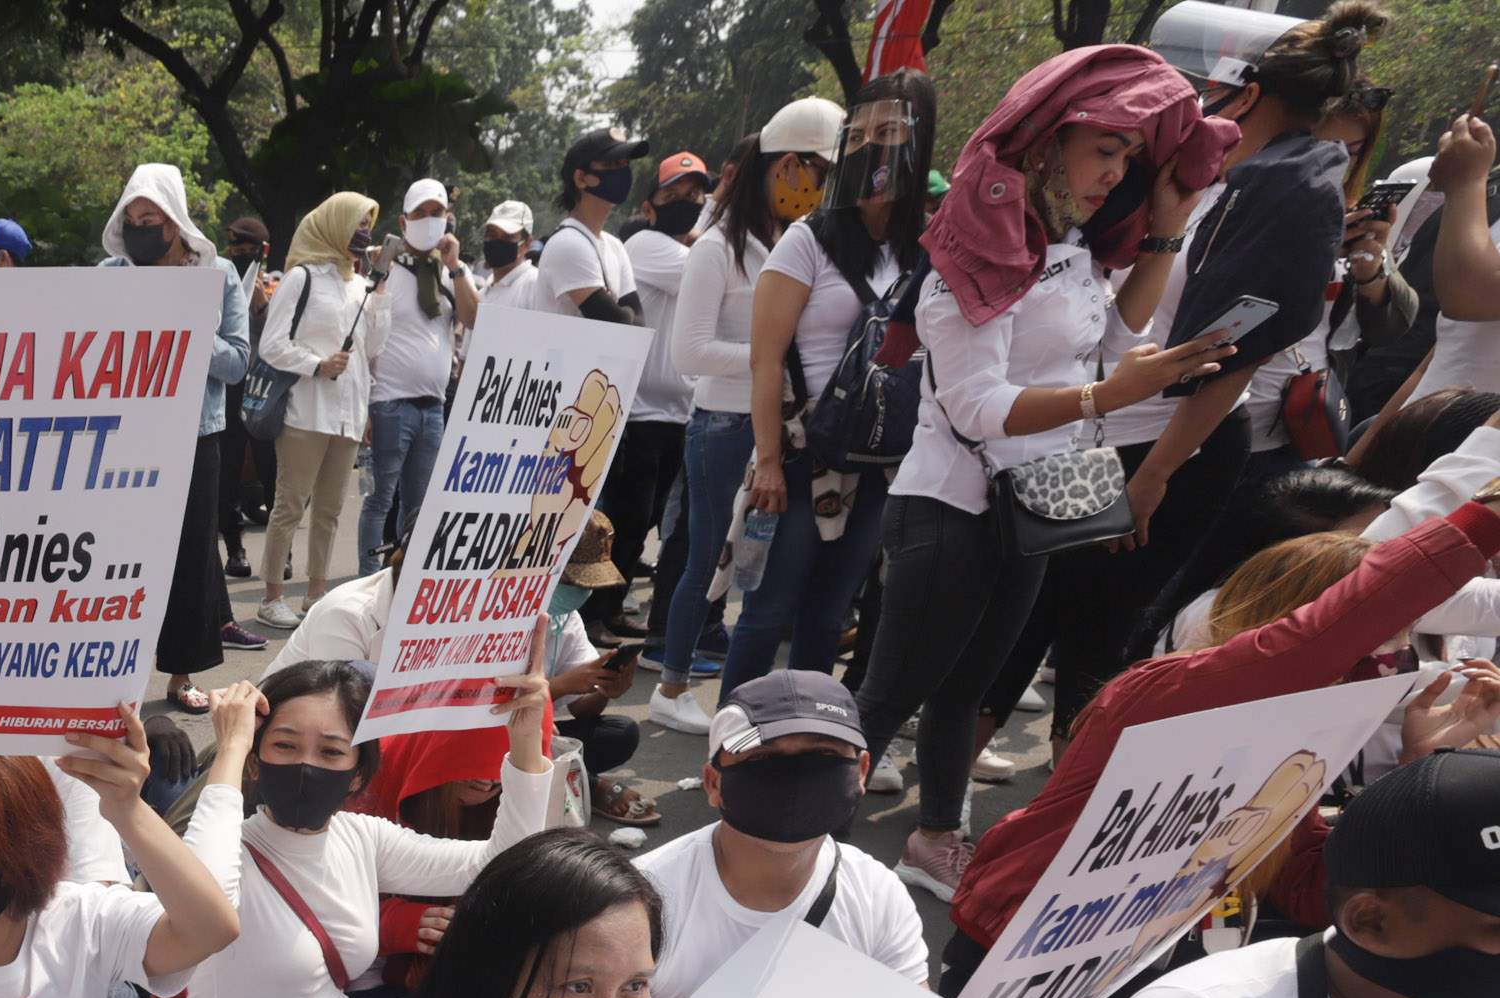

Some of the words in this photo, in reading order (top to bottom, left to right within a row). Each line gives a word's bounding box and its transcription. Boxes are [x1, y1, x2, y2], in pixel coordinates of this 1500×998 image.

[52, 330, 192, 400] KAMI
[468, 355, 513, 425] Pak
[508, 360, 562, 428] Anies
[443, 436, 516, 495] kami
[507, 441, 574, 495] minta
[49, 586, 147, 623] kuat
[407, 578, 484, 625] BUKA
[479, 575, 551, 621] USAHA
[63, 638, 140, 678] KERJA
[392, 637, 452, 674] TEMPAT
[444, 633, 483, 666] KAMI
[474, 629, 534, 664] BEKERJA
[0, 716, 63, 729] HIBURAN
[1068, 782, 1161, 877] Pak
[1129, 766, 1236, 862] Anies
[1004, 873, 1140, 962] kami
